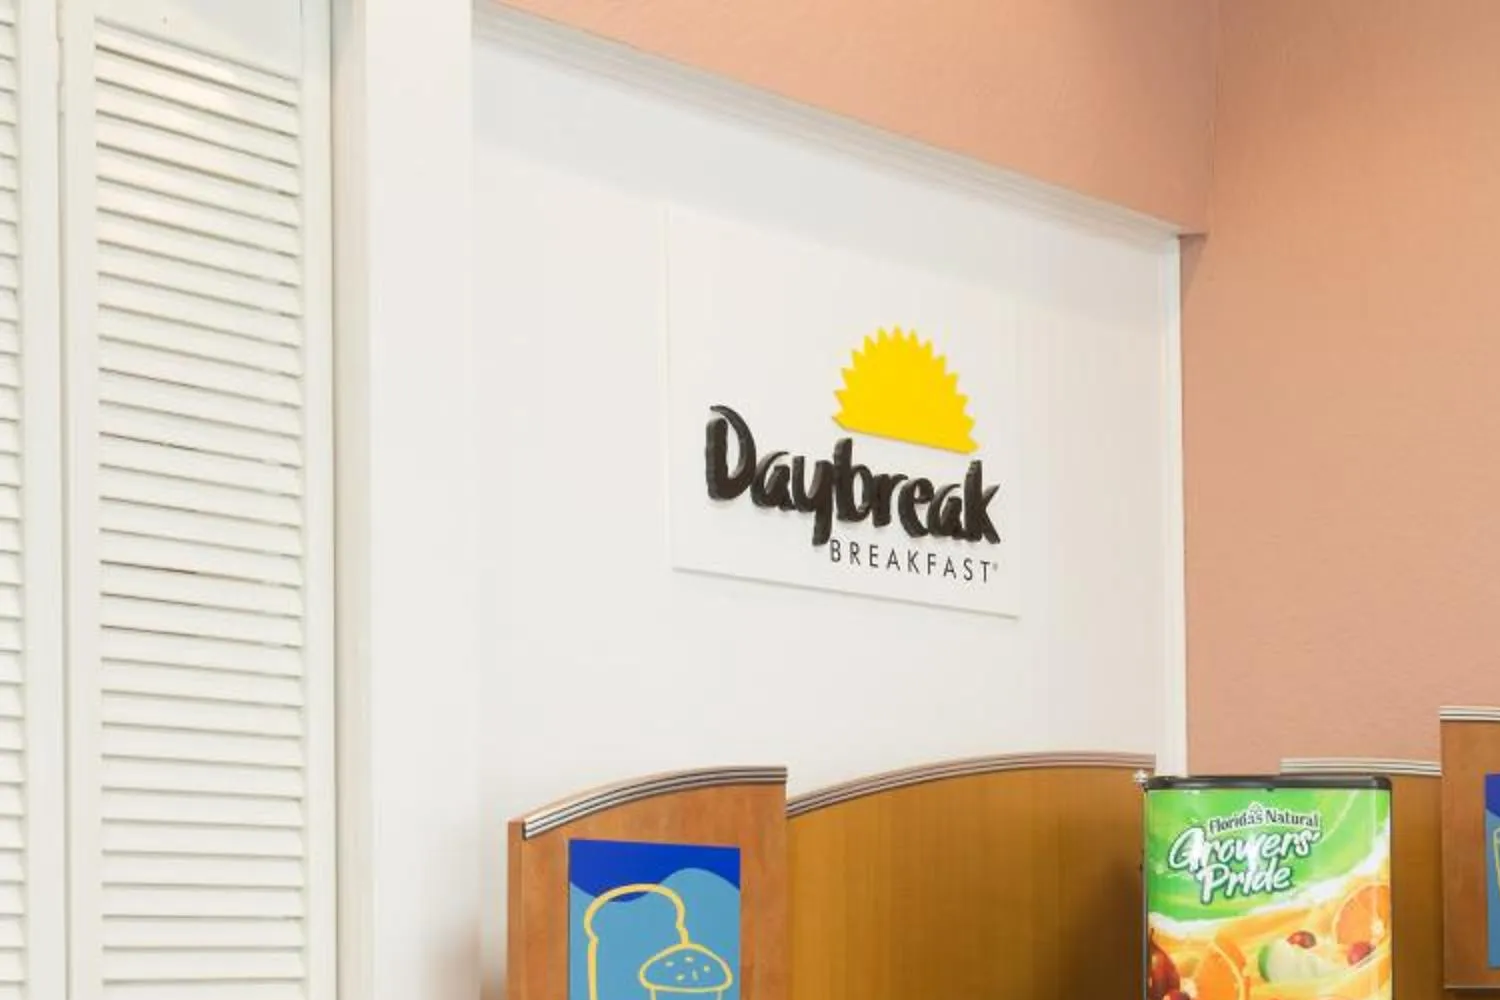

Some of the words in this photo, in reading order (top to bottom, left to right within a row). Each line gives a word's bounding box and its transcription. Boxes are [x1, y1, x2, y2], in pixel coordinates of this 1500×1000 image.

[705, 405, 1001, 546] Daybreak
[830, 539, 991, 583] BREAKFAST
[1265, 809, 1319, 828] Natural
[1168, 828, 1321, 871] Growers'
[1199, 859, 1293, 904] Pride
